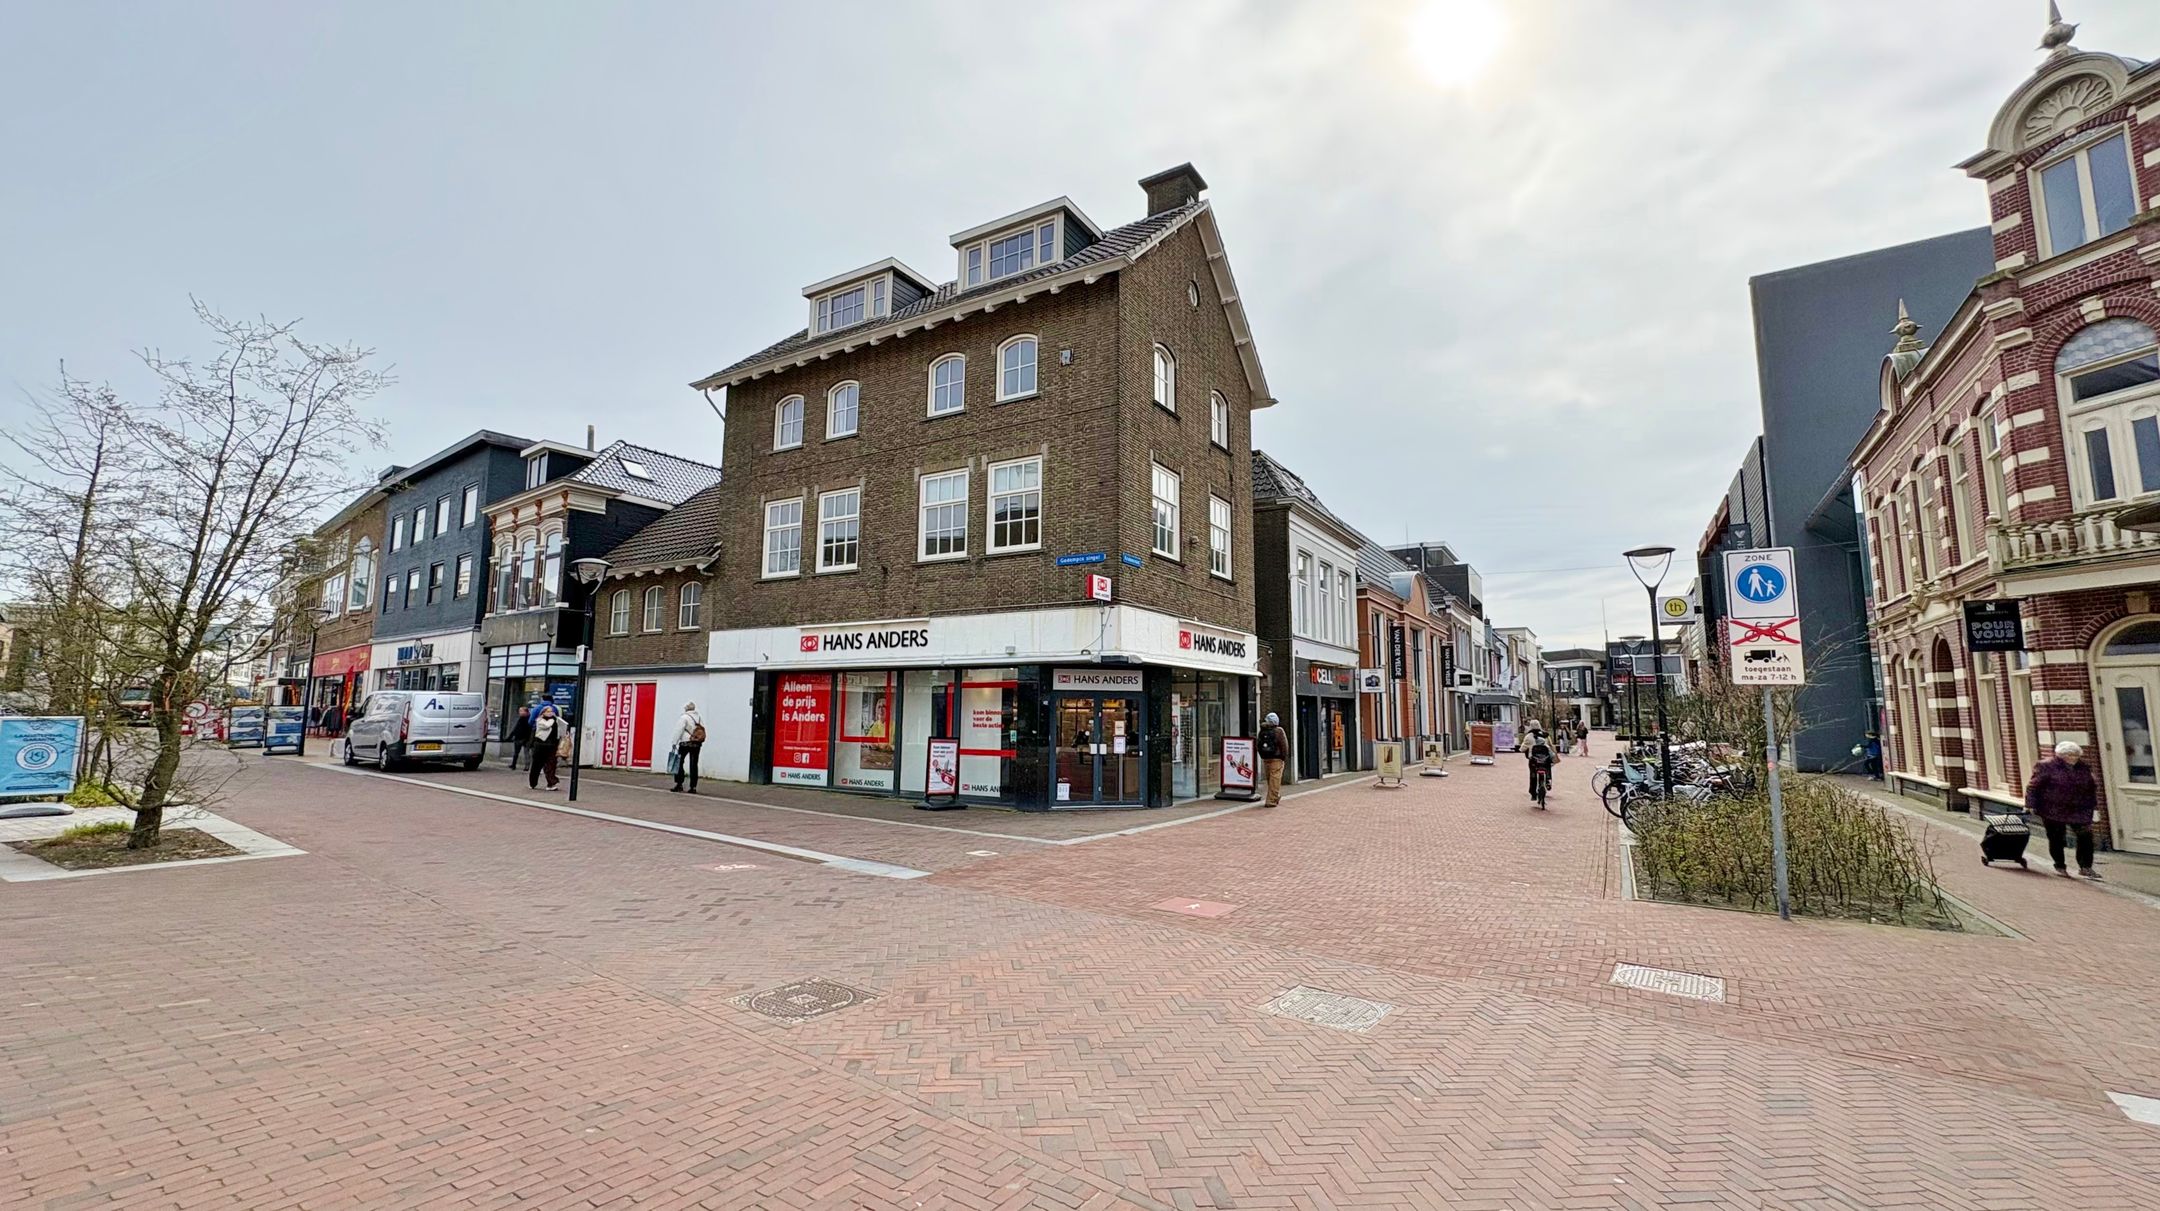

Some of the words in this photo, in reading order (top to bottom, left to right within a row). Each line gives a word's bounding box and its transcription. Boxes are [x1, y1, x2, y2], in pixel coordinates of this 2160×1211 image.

[1744, 553, 1773, 562] ZONE
[1971, 620, 2015, 631] POUR
[823, 632, 863, 651] HANS
[866, 629, 928, 649] ANDERS
[1972, 629, 2017, 639] VOUS
[1193, 633, 1217, 654] HANS
[1217, 638, 1246, 658] ANDERS
[1394, 657, 1402, 677] VELDE
[1744, 666, 1792, 674] toegestaan
[1073, 675, 1100, 684] HANS
[1101, 675, 1139, 685] ANDERS
[783, 681, 812, 693] Alleen
[782, 696, 794, 707] de
[795, 695, 817, 709] prijs
[781, 710, 790, 722] is
[791, 710, 826, 722] Anders
[604, 686, 617, 763] opticiens
[618, 685, 632, 765] audiciens
[801, 772, 821, 780] ANDERS
[971, 784, 989, 792] HANS
